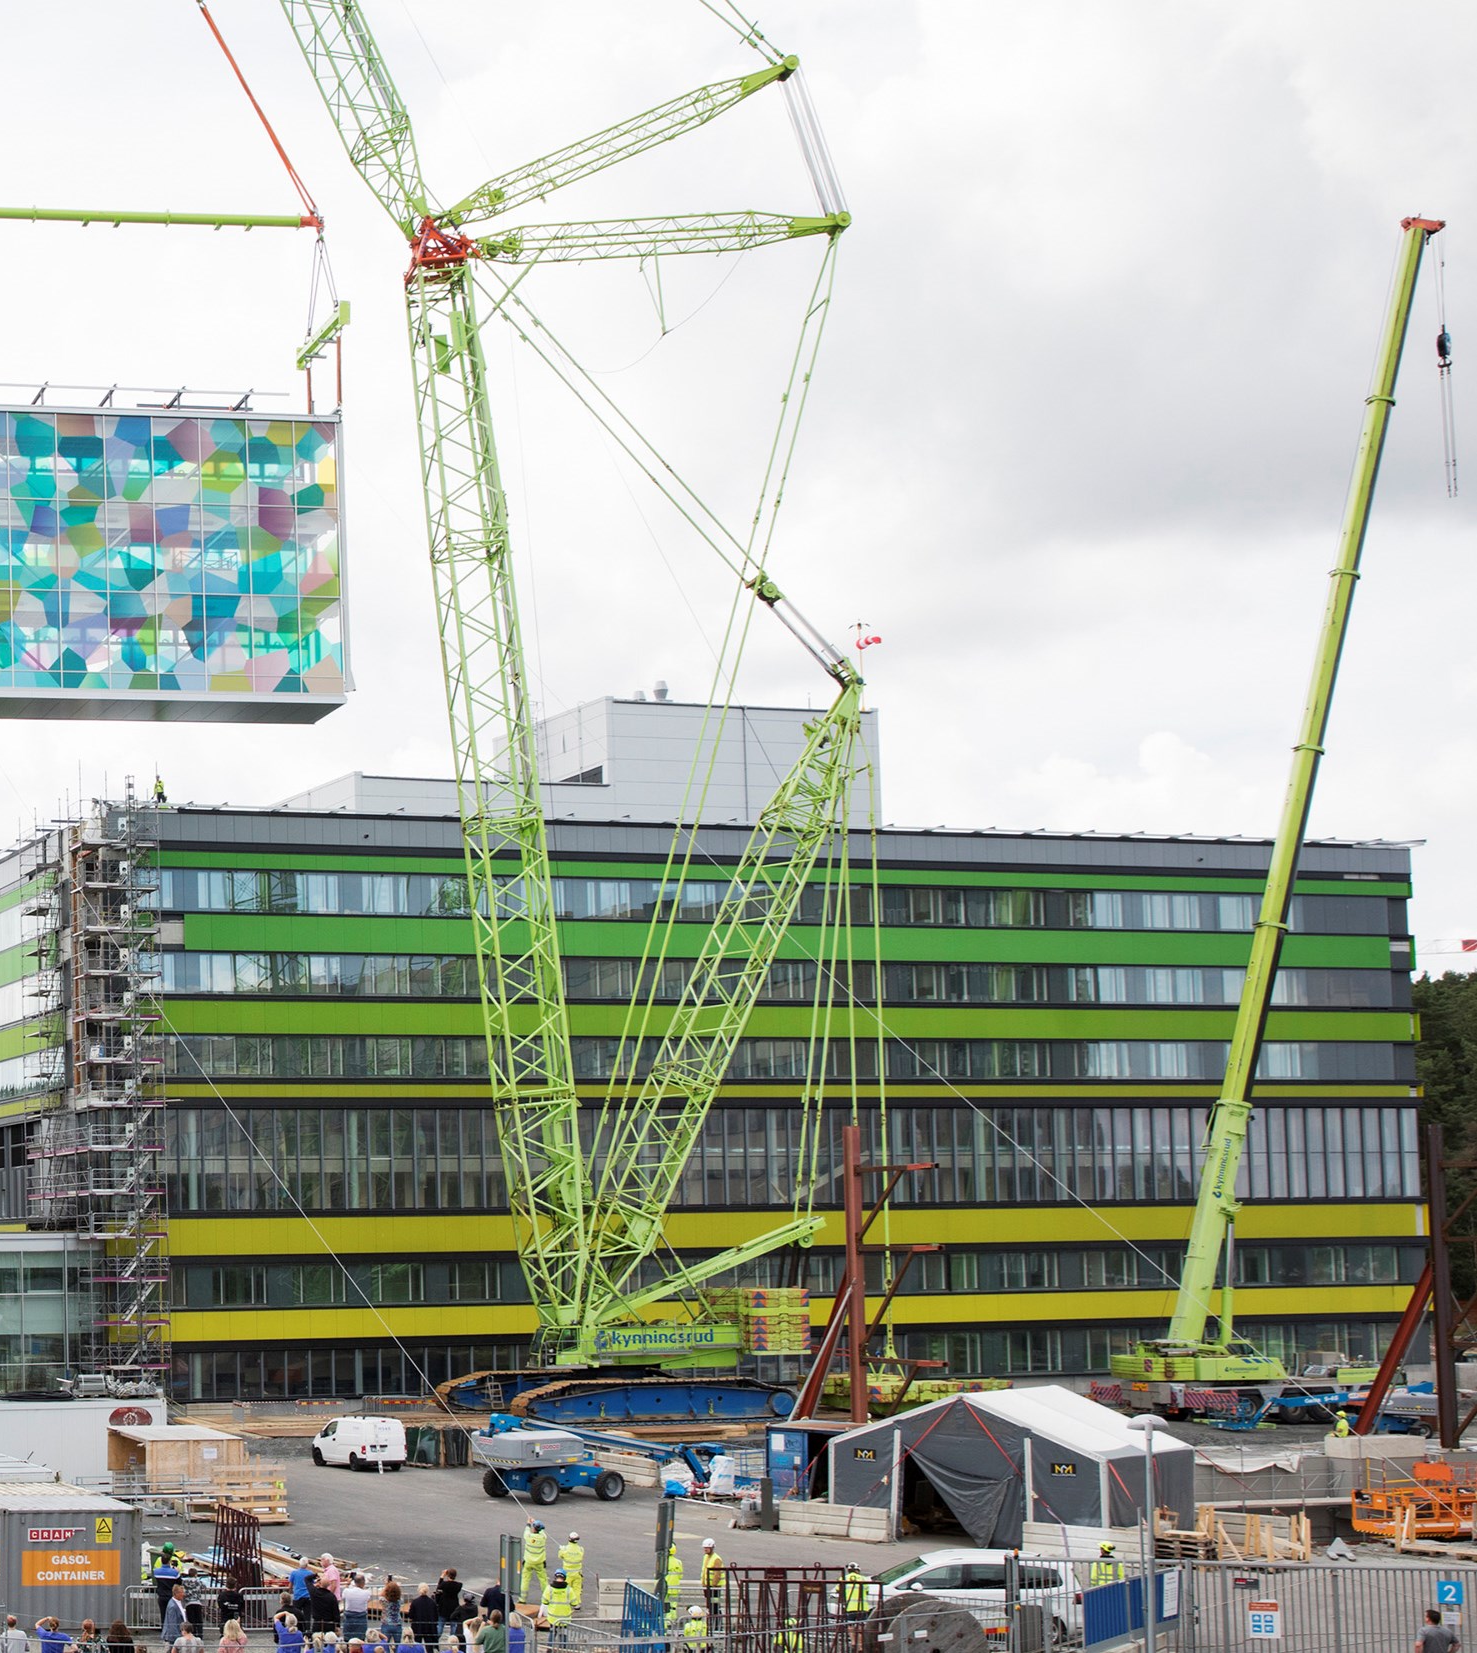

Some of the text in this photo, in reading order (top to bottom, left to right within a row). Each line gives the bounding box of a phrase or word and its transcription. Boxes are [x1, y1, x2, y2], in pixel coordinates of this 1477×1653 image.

[51, 1555, 91, 1565] GASOL
[36, 1571, 105, 1581] CONTAINER
[1443, 1585, 1457, 1601] 2
